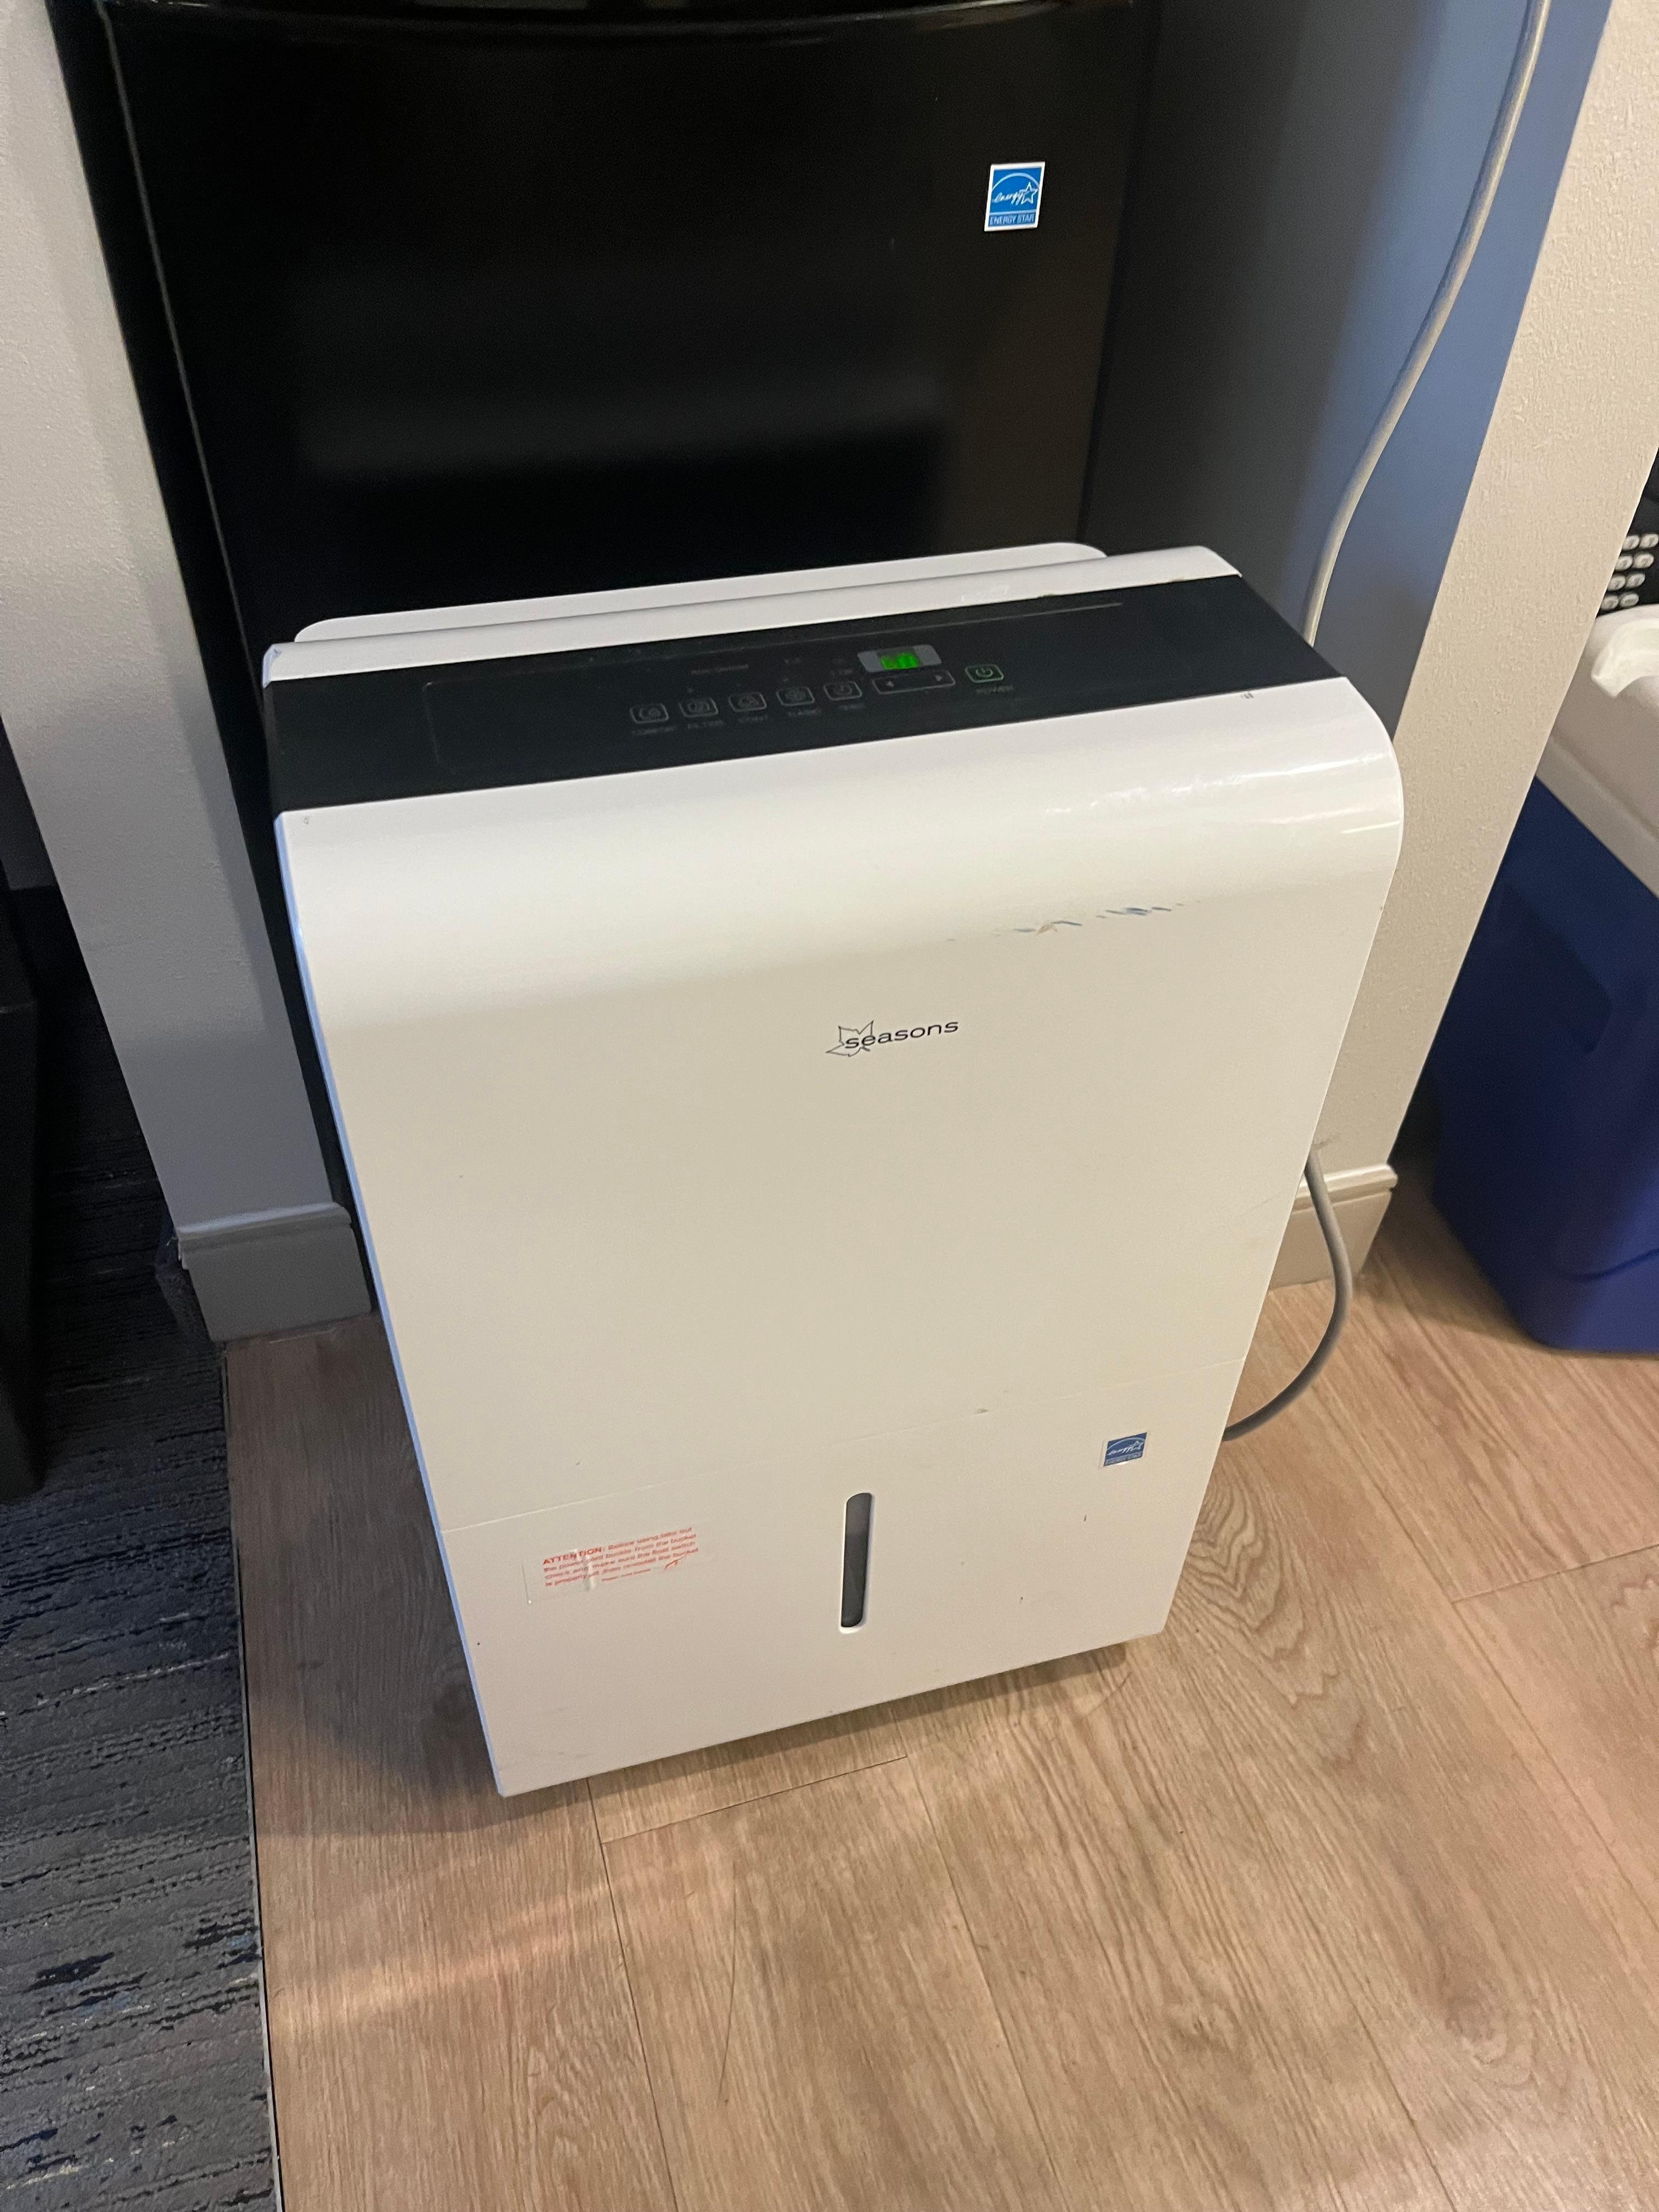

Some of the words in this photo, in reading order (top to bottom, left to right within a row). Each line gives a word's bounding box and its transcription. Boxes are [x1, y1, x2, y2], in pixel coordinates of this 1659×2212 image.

[990, 215, 1017, 225] ENERGY
[1018, 213, 1035, 224] STAR
[845, 1021, 959, 1049] seasons
